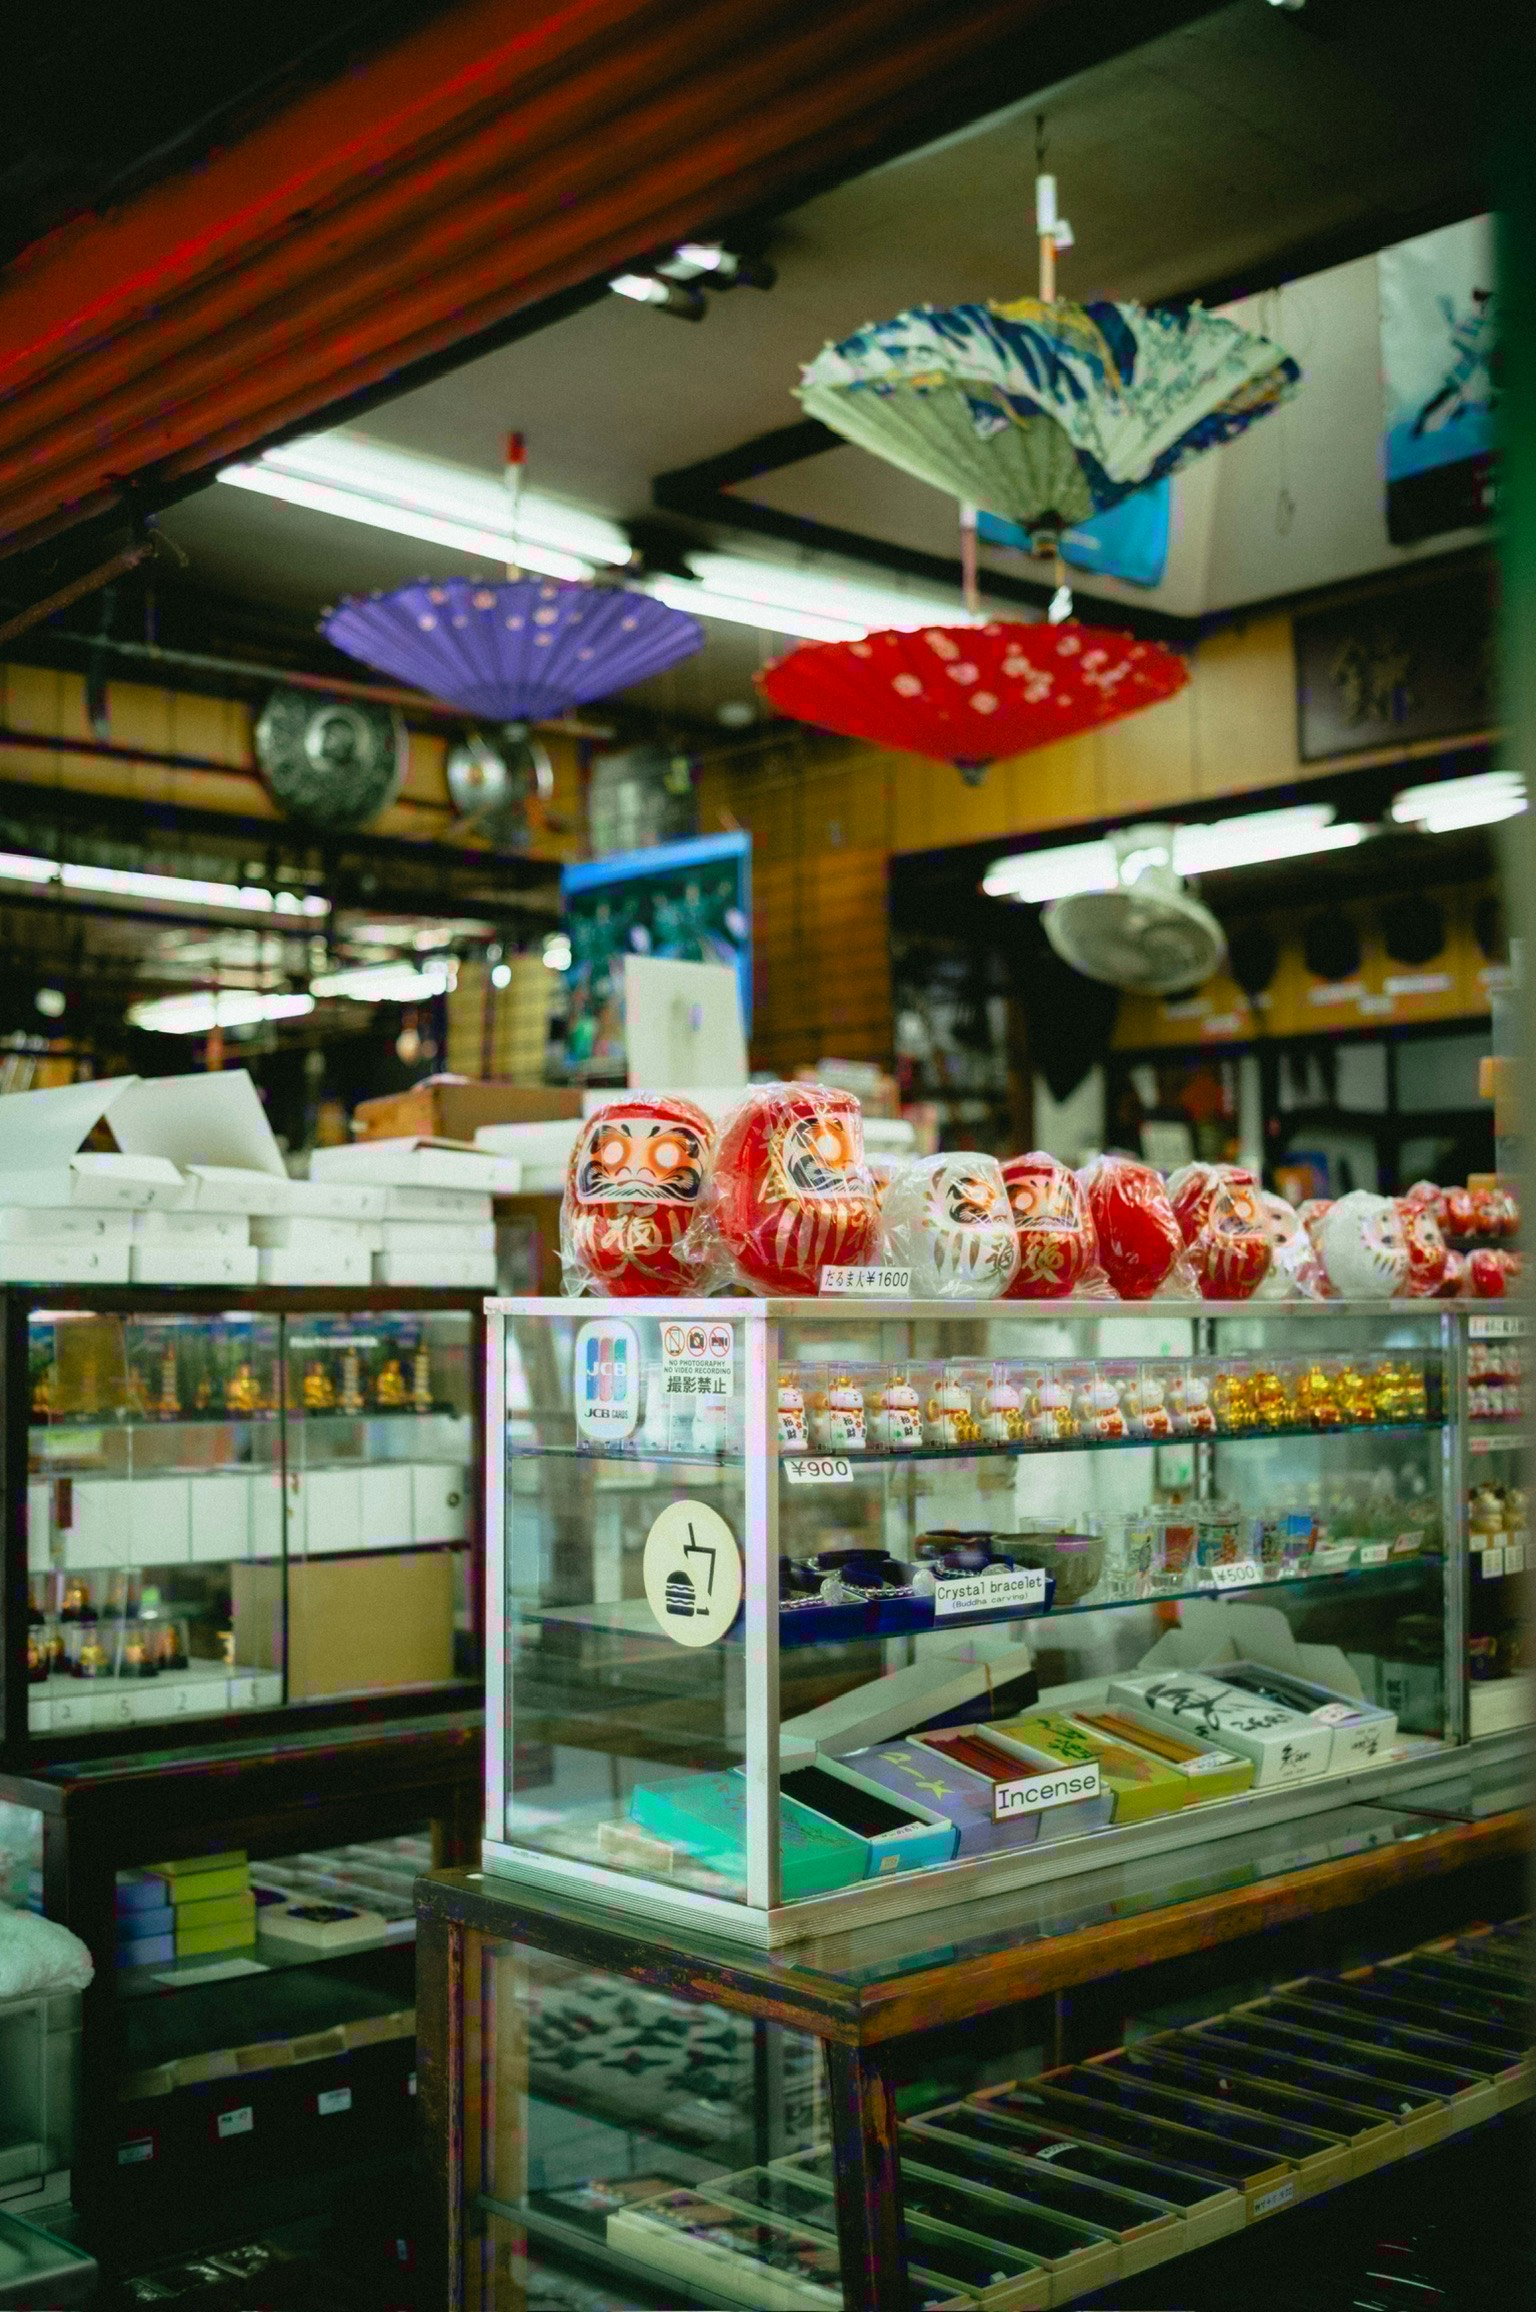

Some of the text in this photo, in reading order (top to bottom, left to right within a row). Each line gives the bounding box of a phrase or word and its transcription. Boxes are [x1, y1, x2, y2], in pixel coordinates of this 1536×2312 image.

[586, 1361, 626, 1376] JCB
[663, 1366, 732, 1375] NO VIDEO RECORDING
[668, 1359, 726, 1367] NO PHOTOGRAPHY
[666, 1376, 727, 1394] 撮影禁止
[584, 1408, 610, 1419] JCB
[791, 1460, 849, 1477] ¥900
[1215, 1565, 1255, 1582] ¥500
[937, 1576, 1042, 1601] Crystal bracelet
[952, 1592, 1029, 1609] (Buddha carving)
[998, 1775, 1096, 1810] Incense
